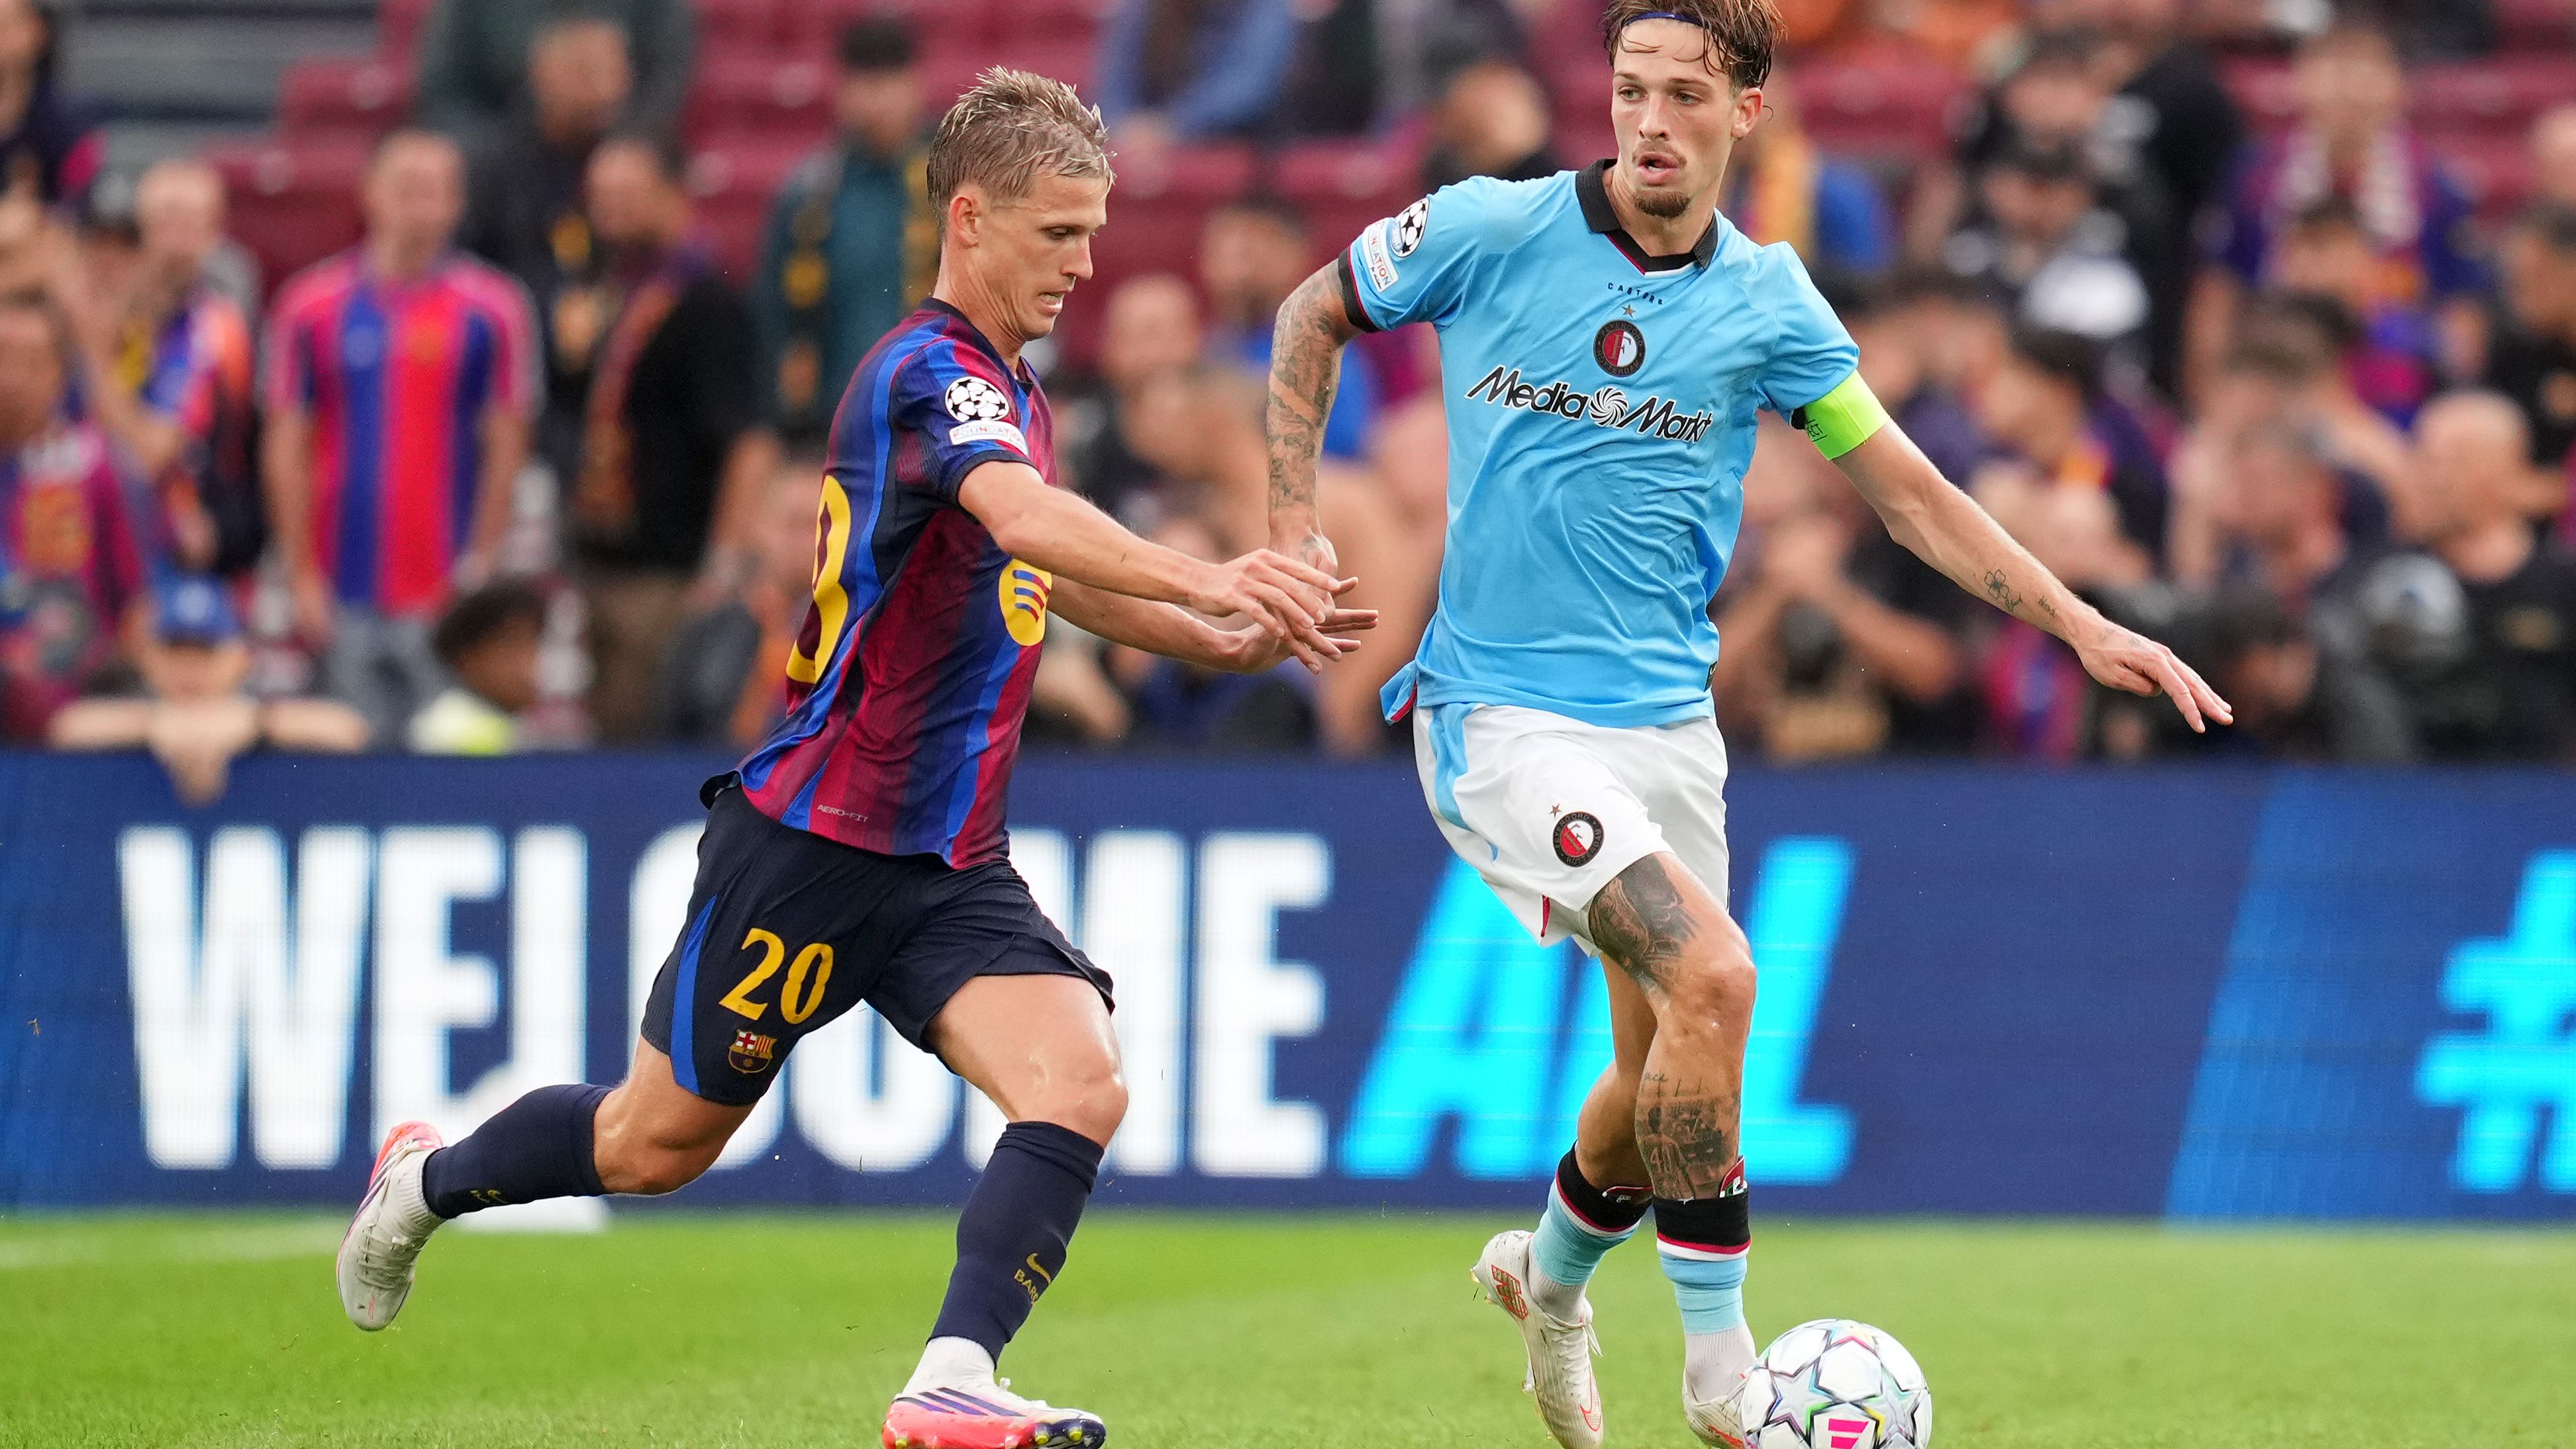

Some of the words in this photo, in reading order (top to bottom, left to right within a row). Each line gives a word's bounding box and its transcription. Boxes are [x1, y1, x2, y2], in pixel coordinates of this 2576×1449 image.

[1369, 228, 1391, 286] NDATION
[1465, 365, 1591, 421] Media
[1617, 396, 1713, 443] Markt
[817, 804, 869, 823] AERO-FIT
[718, 928, 834, 1024] 20
